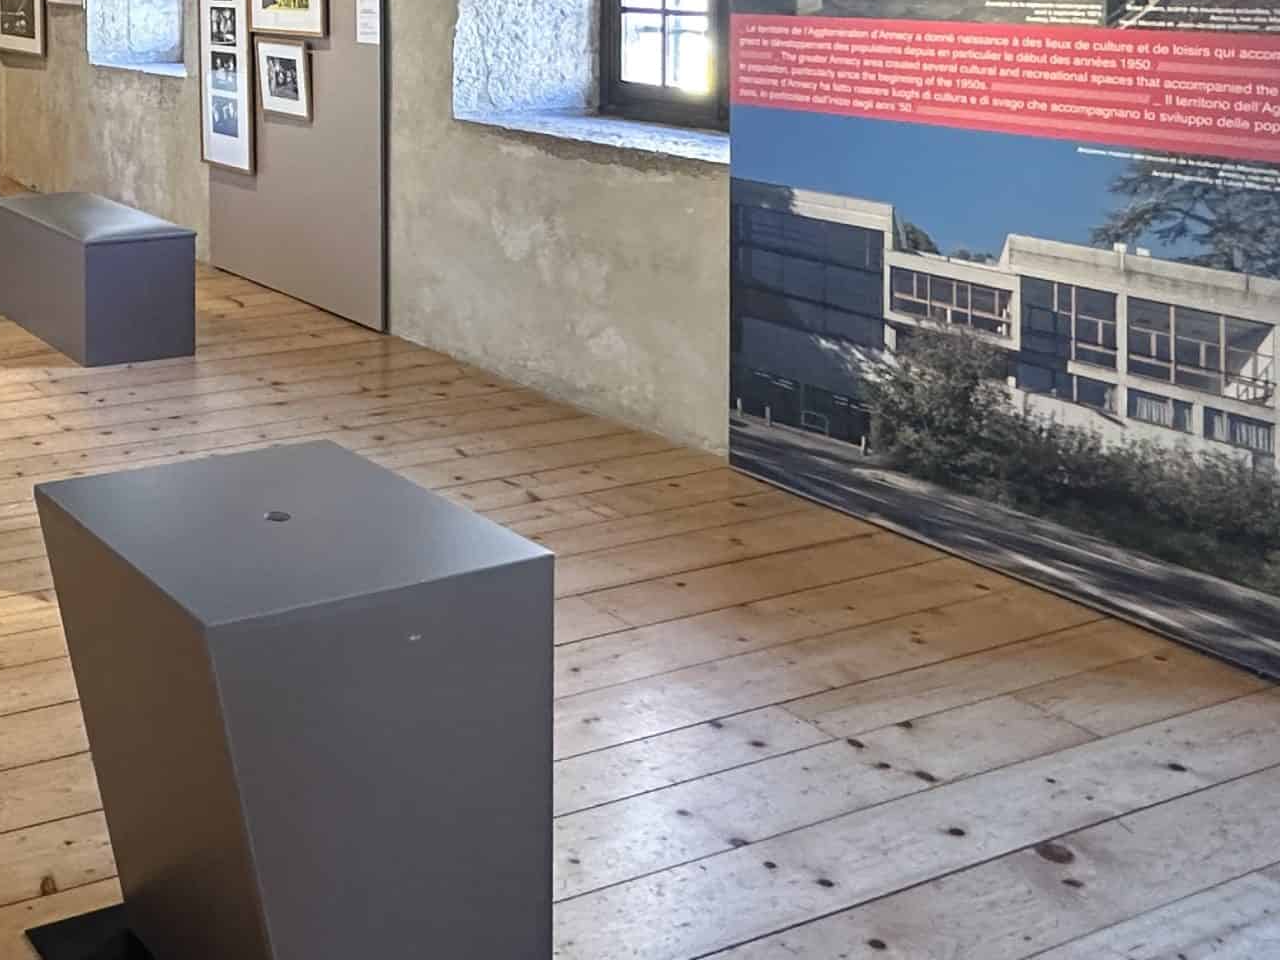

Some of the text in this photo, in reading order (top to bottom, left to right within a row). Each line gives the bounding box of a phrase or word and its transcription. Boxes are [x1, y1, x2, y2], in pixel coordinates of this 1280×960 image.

[1022, 36, 1042, 48] des
[1074, 40, 1090, 50] de
[1093, 40, 1134, 53] culture
[1137, 43, 1150, 54] et
[1152, 42, 1169, 55] de
[1173, 44, 1210, 57] loisirs
[1214, 48, 1235, 59] qui
[1050, 54, 1071, 65] des
[1073, 54, 1117, 68] années
[1022, 69, 1088, 82] recreational
[1090, 73, 1133, 86] spaces
[1136, 75, 1160, 87] that
[1164, 80, 1252, 95] accompanied
[1256, 84, 1279, 96] the
[1027, 100, 1048, 112] che
[1051, 103, 1140, 120] accompagnano
[1144, 108, 1156, 121] lo
[1160, 112, 1213, 128] sviluppo
[1217, 117, 1250, 129] delle
